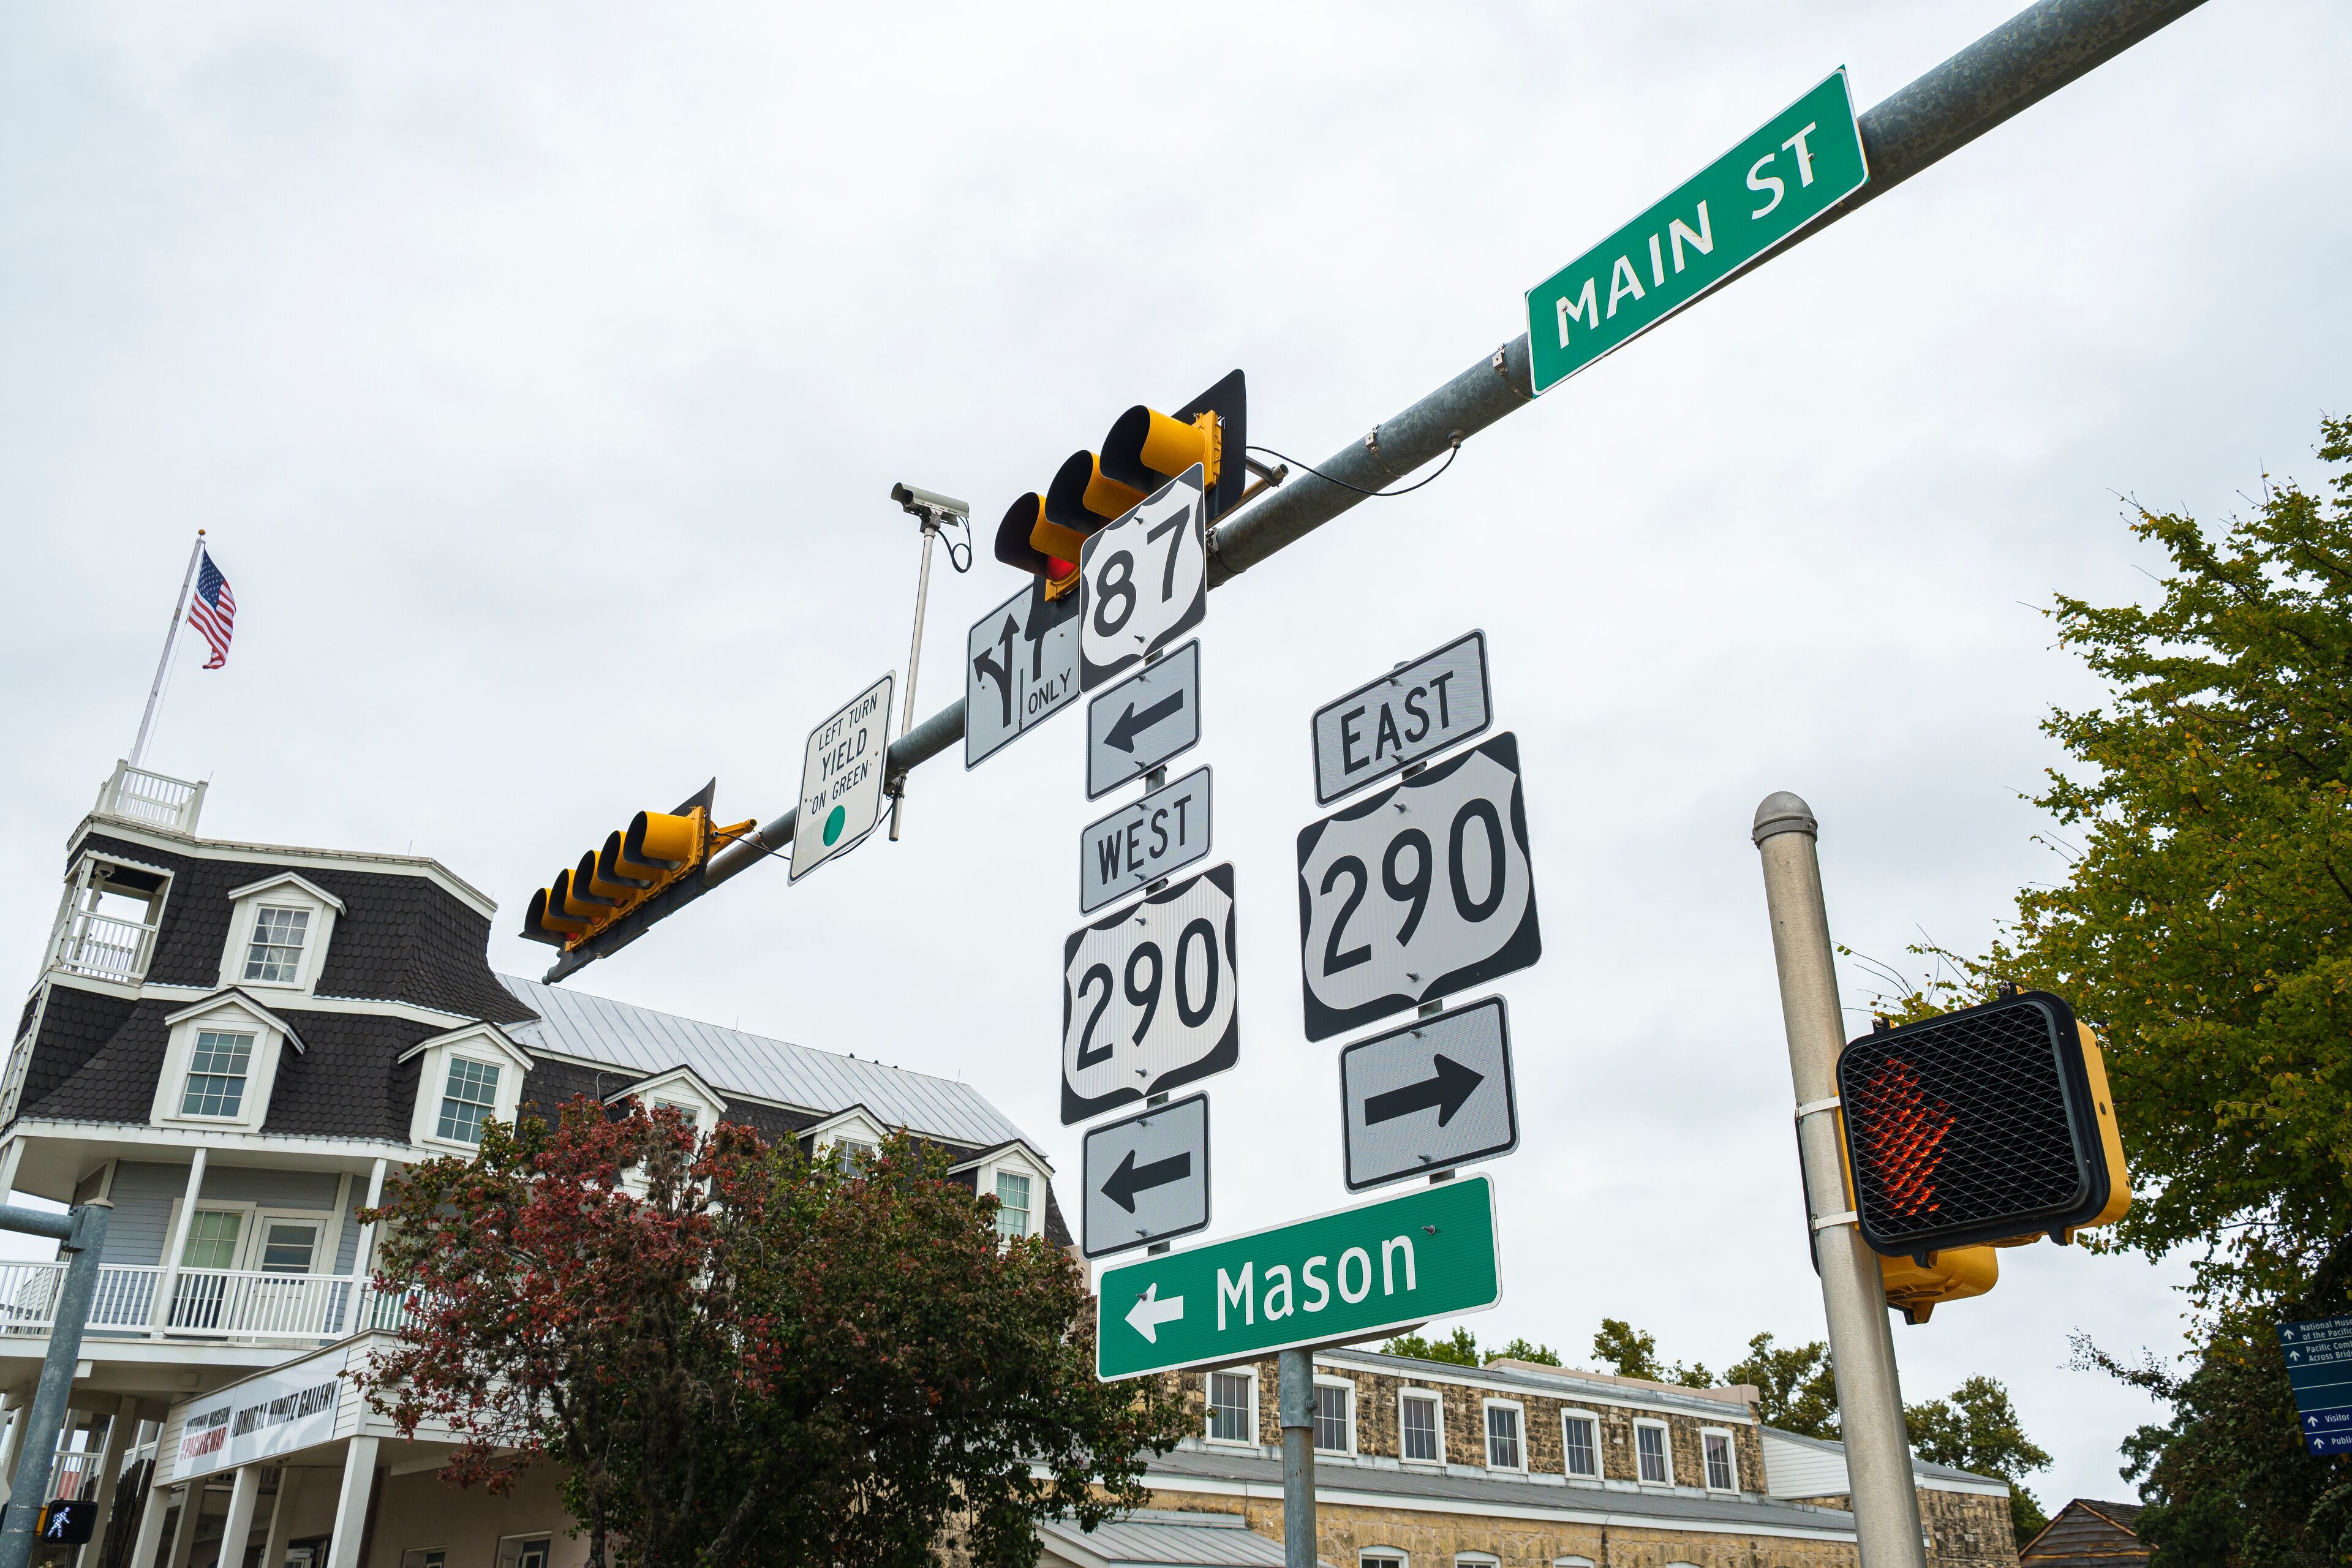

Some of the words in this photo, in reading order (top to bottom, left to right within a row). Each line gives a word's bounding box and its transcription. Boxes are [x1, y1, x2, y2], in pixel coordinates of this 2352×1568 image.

[1556, 200, 1713, 349] MAIN
[1746, 121, 1816, 220] ST
[1093, 504, 1189, 638] 87
[1028, 667, 1071, 715] ONLY
[818, 718, 843, 752] LEFT
[849, 692, 877, 728] TURN
[1341, 671, 1453, 775] EAST
[823, 728, 867, 782] YIELD
[812, 790, 826, 815] ON
[832, 760, 869, 800] GREEN
[1098, 794, 1191, 886] WEST
[1320, 798, 1506, 978] 290
[1077, 918, 1219, 1072] 290
[1217, 1235, 1416, 1331] Mason
[2300, 1321, 2332, 1332] National
[2306, 1343, 2331, 1353] Pacific
[2309, 1353, 2333, 1362] Across
[2335, 1349, 2352, 1359] Brid
[185, 1413, 209, 1436] NATIONAL
[208, 1406, 232, 1428] MUSEUM
[230, 1403, 268, 1438] ADMIRAL
[267, 1392, 300, 1427] NIMITZ
[298, 1379, 337, 1419] GALLERY
[2325, 1414, 2350, 1422] Visitor
[184, 1431, 211, 1460] PACIFIC
[209, 1427, 227, 1453] WAR
[2332, 1436, 2352, 1445] Publi
